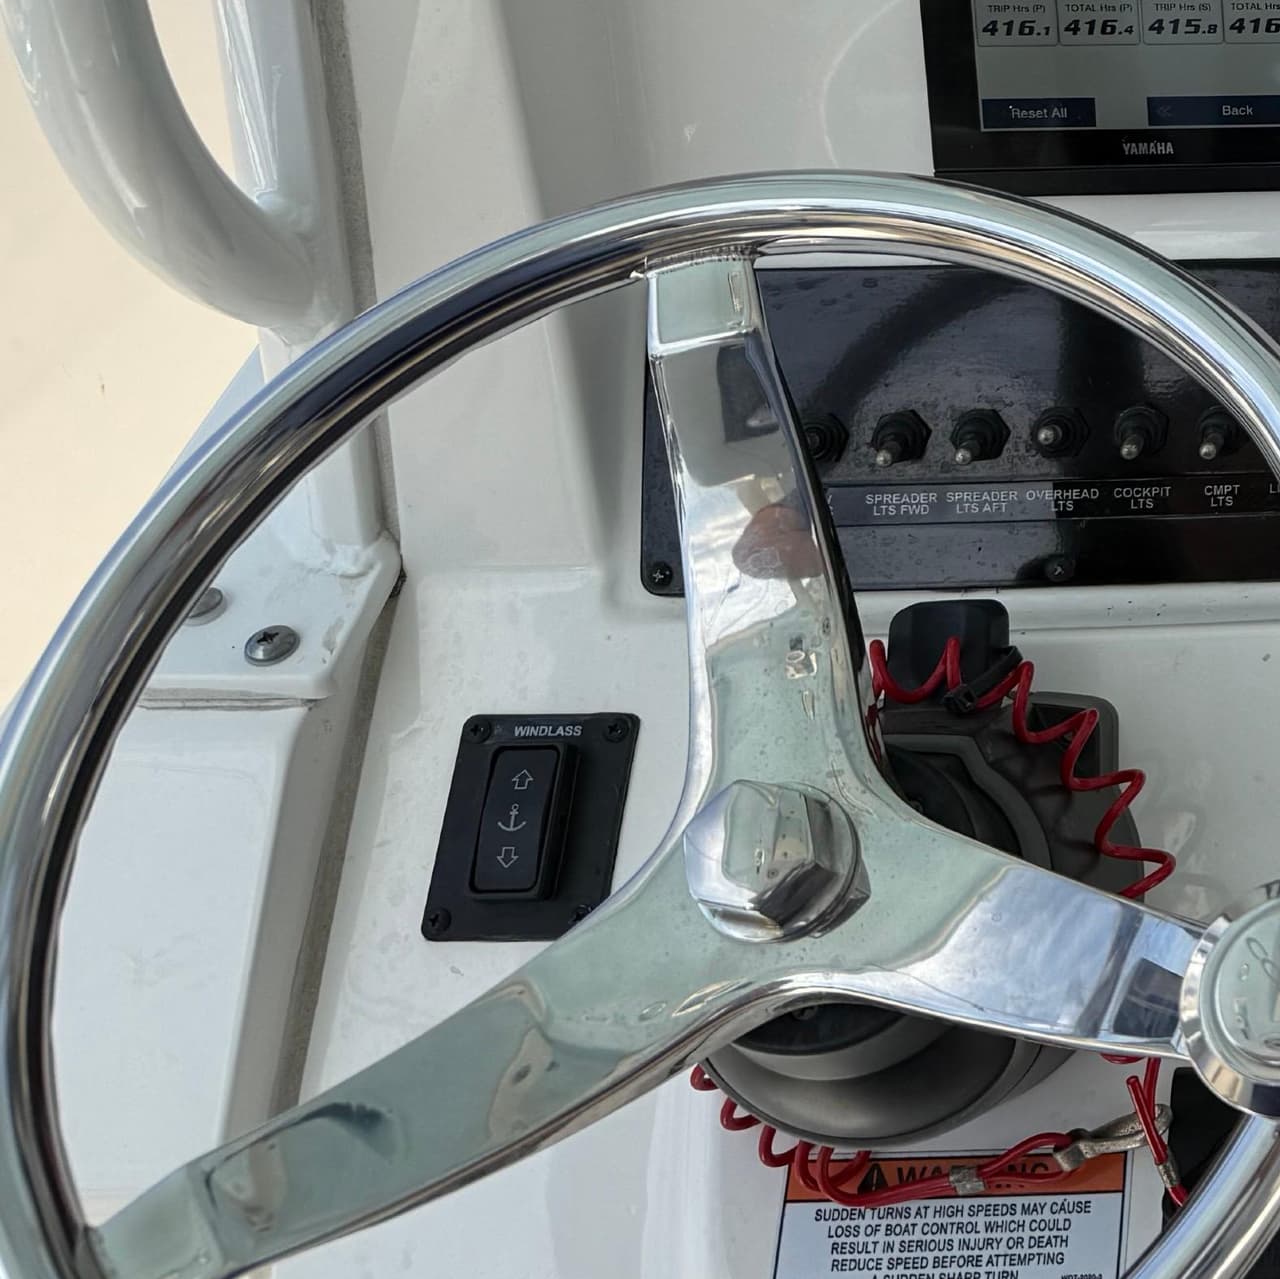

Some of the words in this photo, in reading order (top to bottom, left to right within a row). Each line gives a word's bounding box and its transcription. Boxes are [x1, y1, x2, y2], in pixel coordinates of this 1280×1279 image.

[982, 19, 1050, 36] 416.1
[1064, 19, 1134, 35] 416.4
[1148, 18, 1218, 35] 415.8
[1011, 107, 1048, 119] Reset
[1051, 108, 1068, 119] All
[1222, 105, 1253, 116] Back
[1122, 141, 1173, 155] YAMAHA
[946, 490, 1018, 502] SPREADER
[1026, 488, 1100, 500] OVERHEAD
[1113, 487, 1171, 499] COCKPIT
[1204, 484, 1240, 496] CMPT
[865, 493, 938, 505] SPREADER
[1131, 497, 1154, 509] LTS
[1210, 495, 1233, 507] LTS
[873, 504, 897, 515] LTS
[900, 503, 929, 514] FWD
[956, 502, 981, 514] LTS
[983, 501, 1008, 512] AFT
[1050, 500, 1074, 512] LTS
[514, 726, 582, 737] WINDLASS
[815, 1208, 866, 1221] SUDDEN
[870, 1207, 911, 1220] TURNS
[914, 1206, 930, 1219] AT
[933, 1205, 964, 1218] HIGH
[968, 1203, 1017, 1217] SPEEDS
[1021, 1202, 1047, 1216] MAY
[1050, 1201, 1091, 1214] CAUSE
[828, 1225, 860, 1238] LOSS
[864, 1224, 881, 1237] OF
[885, 1223, 918, 1236] BOAT
[921, 1221, 980, 1236] CONTROL
[985, 1220, 1025, 1233] WHICH
[1029, 1218, 1071, 1231] COULD
[831, 1241, 879, 1255] RESULT
[883, 1241, 894, 1253] IN
[898, 1239, 954, 1253] SERIOUS
[958, 1238, 1003, 1251] INJURY
[1006, 1237, 1024, 1250] OR
[1028, 1235, 1068, 1248] DEATH
[831, 1258, 883, 1272] REDUCE
[887, 1257, 929, 1270] SPEED
[932, 1255, 983, 1268] BEFORE
[986, 1252, 1064, 1267] ATTEMPTING
